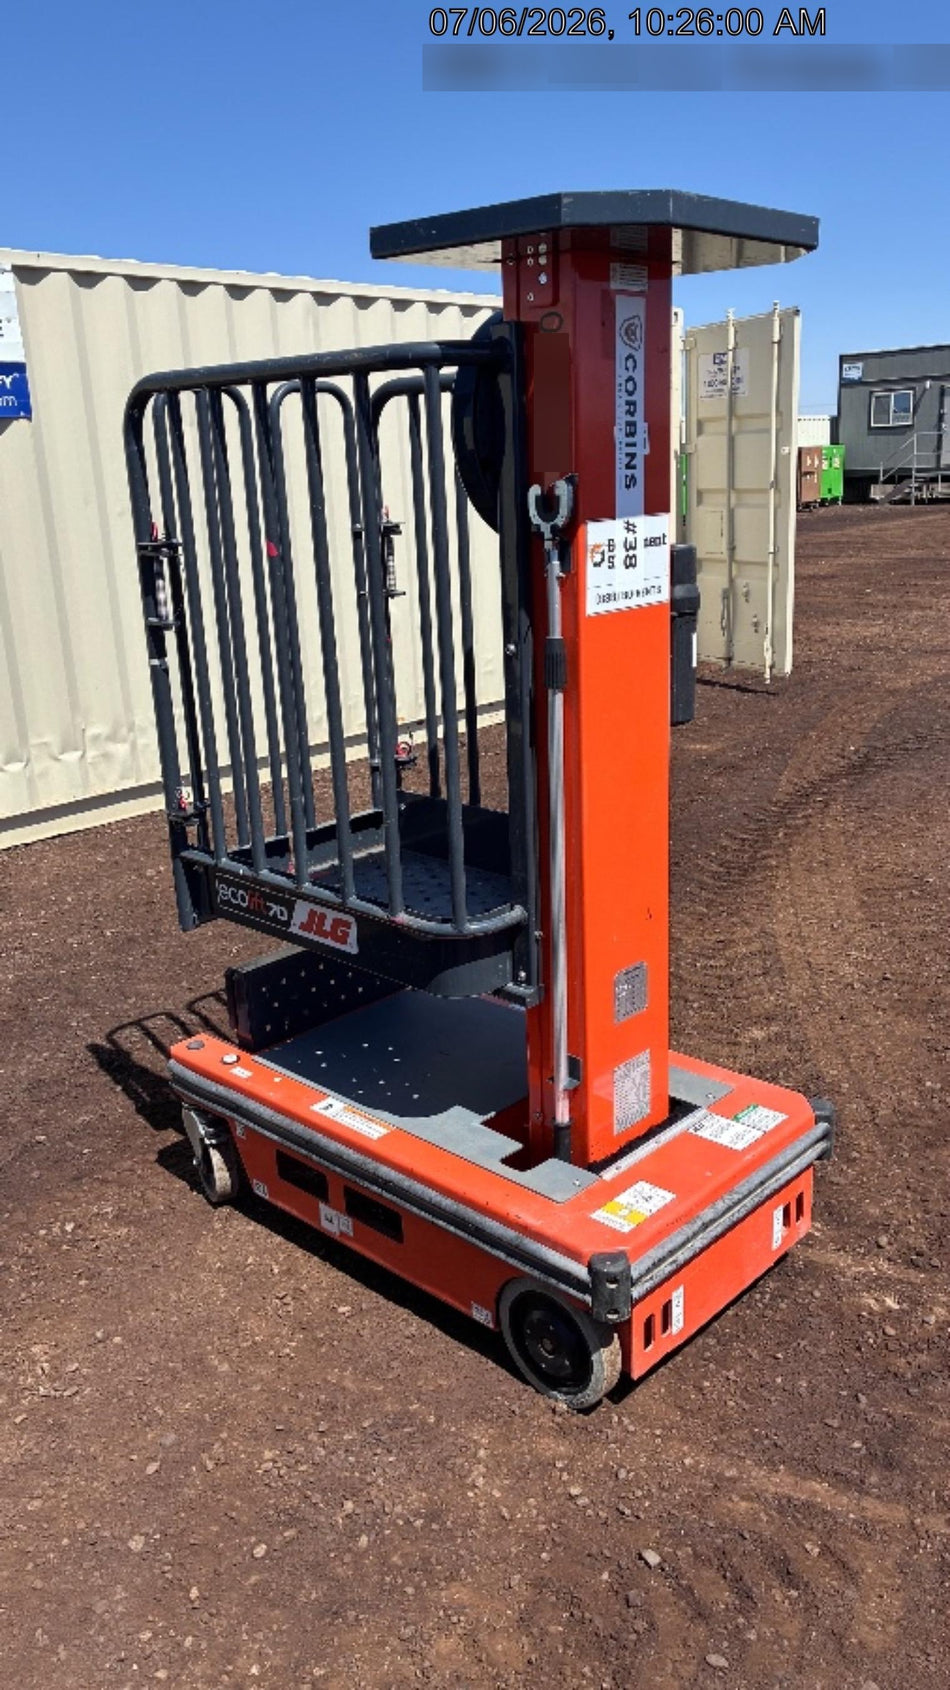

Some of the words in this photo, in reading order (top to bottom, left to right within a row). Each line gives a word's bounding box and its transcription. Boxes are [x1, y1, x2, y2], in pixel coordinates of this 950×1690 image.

[624, 352, 638, 491] CORBINS
[623, 518, 638, 570] #38
[298, 908, 353, 946] JLG
